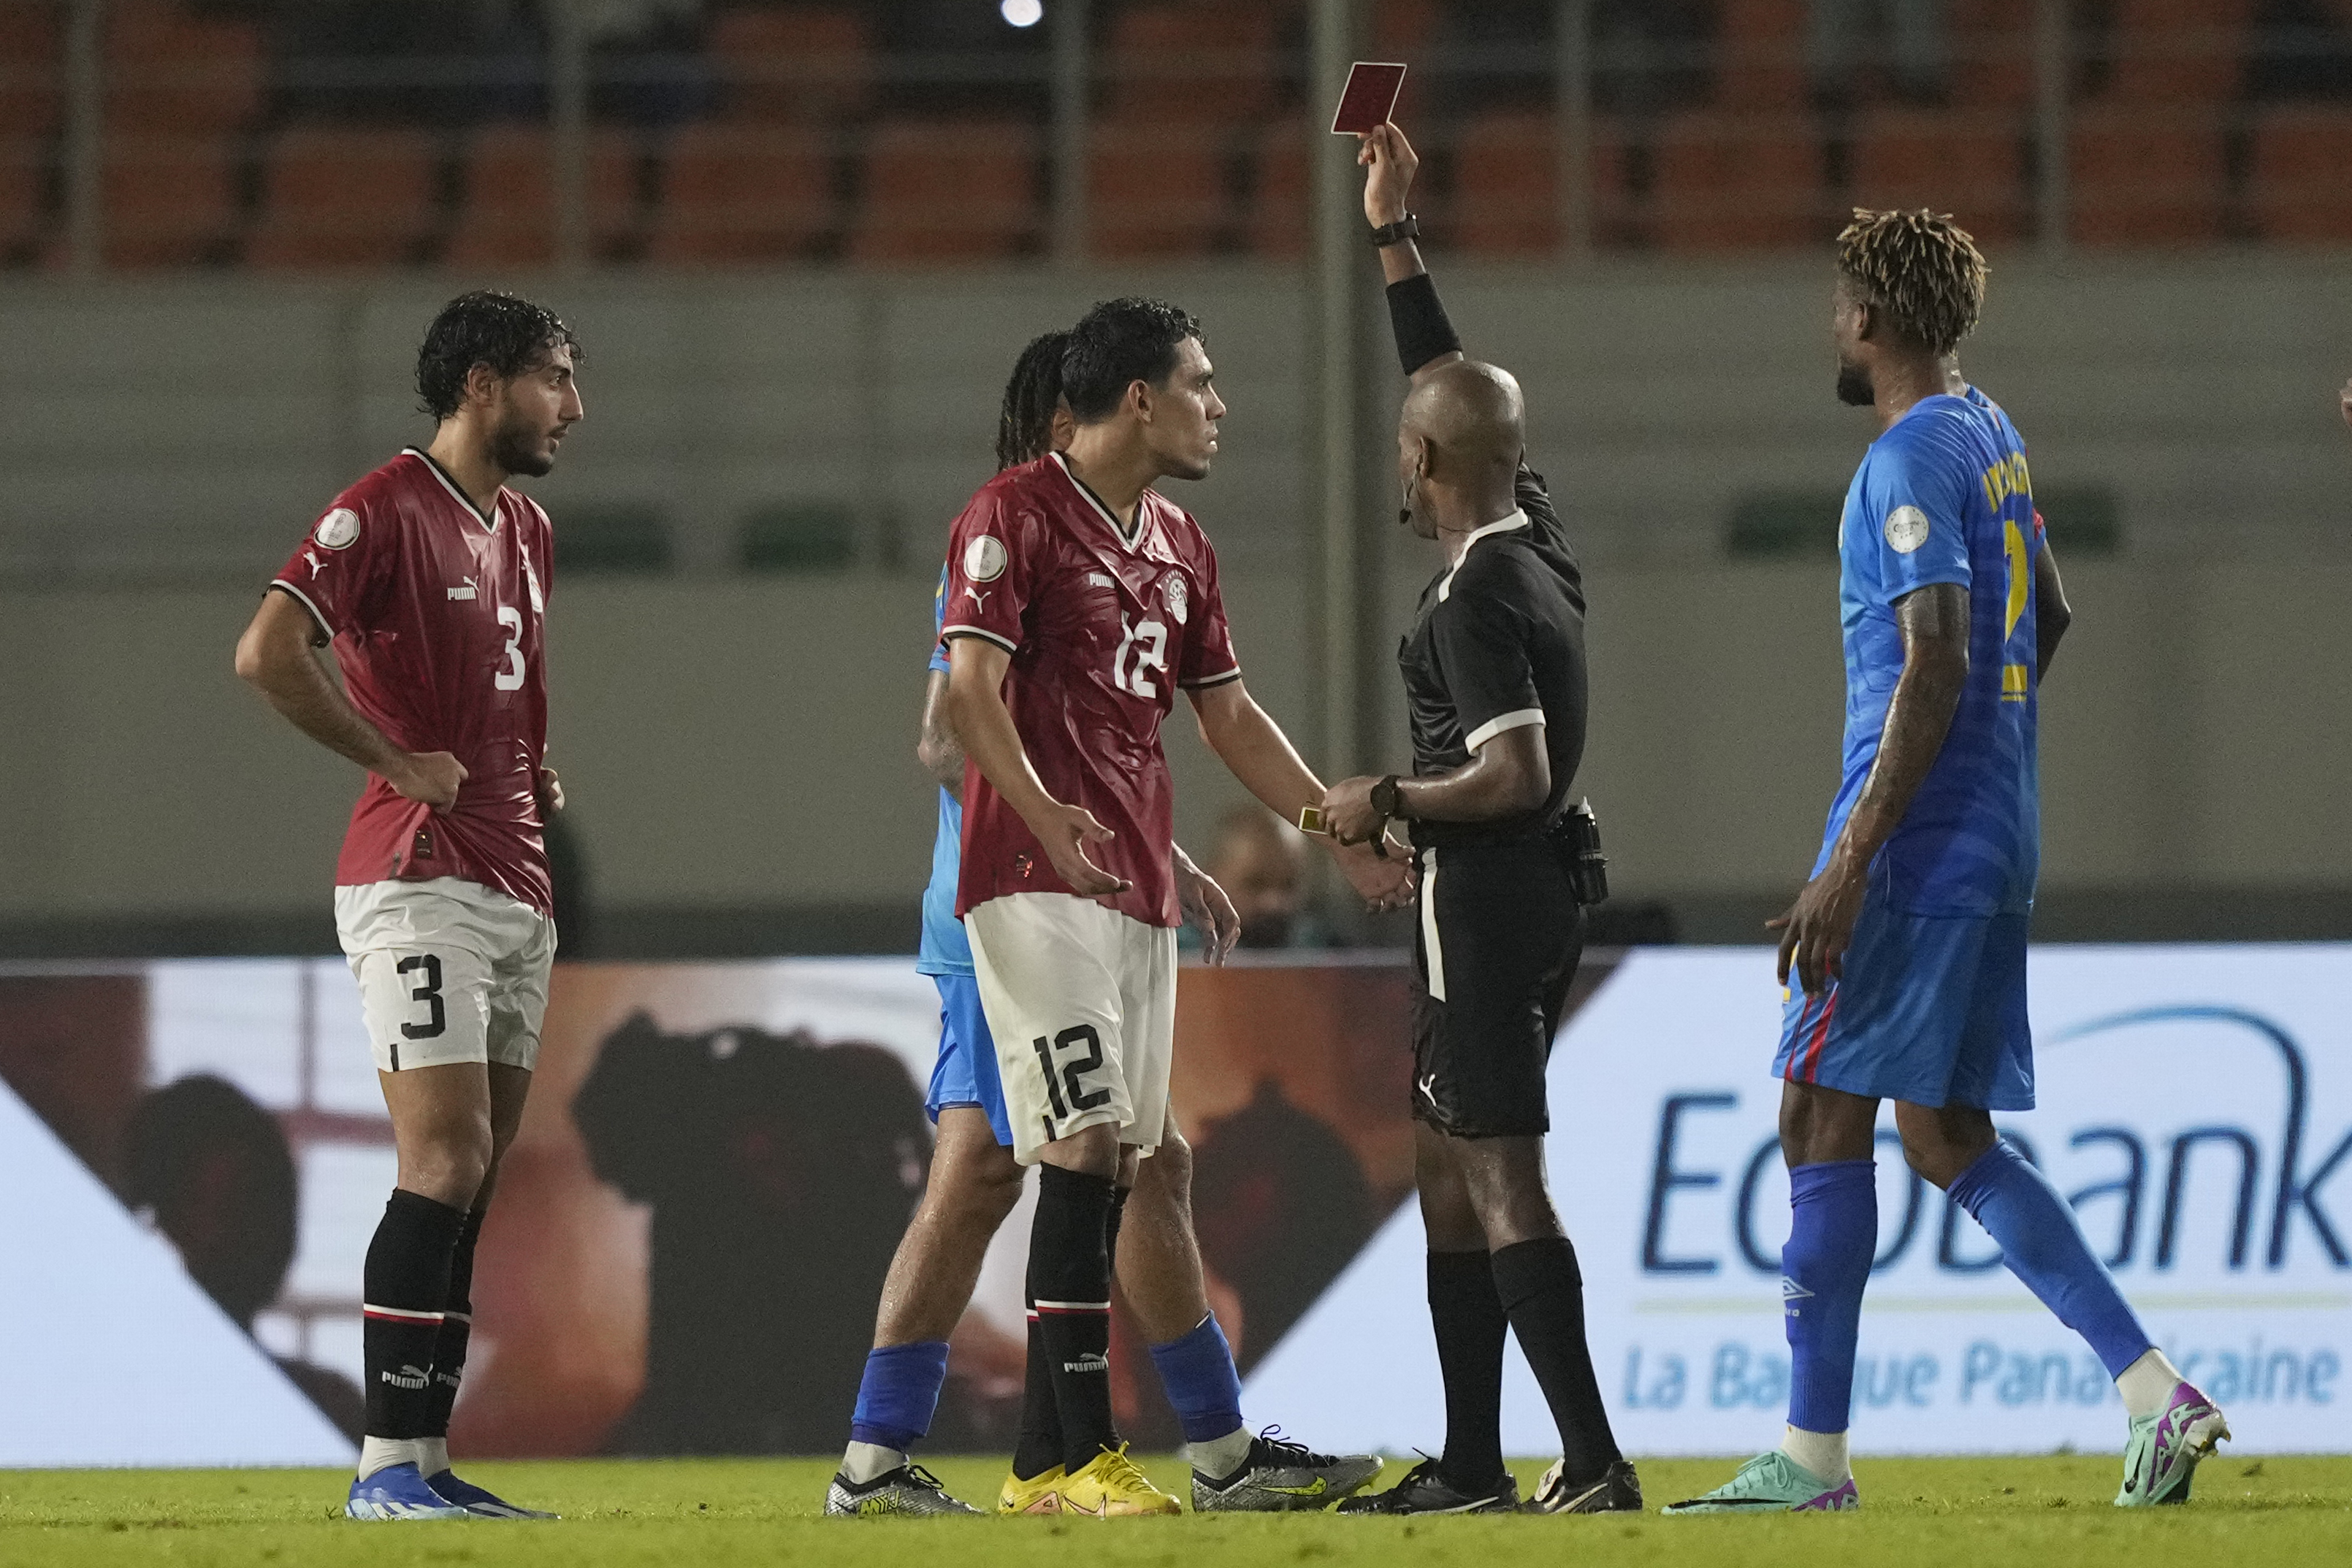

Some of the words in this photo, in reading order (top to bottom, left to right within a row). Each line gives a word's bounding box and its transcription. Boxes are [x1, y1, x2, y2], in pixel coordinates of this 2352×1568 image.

[447, 586, 476, 601] PUMA
[1089, 573, 1115, 589] PUMA
[495, 606, 526, 691] 3
[1114, 609, 1168, 699] 12
[397, 954, 446, 1039] 3
[1033, 1024, 1111, 1120] 12
[381, 1370, 425, 1389] PUMA
[1622, 1343, 1687, 1409] La
[1710, 1341, 1940, 1420] Baue
[1958, 1336, 2341, 1406] Panacaine
